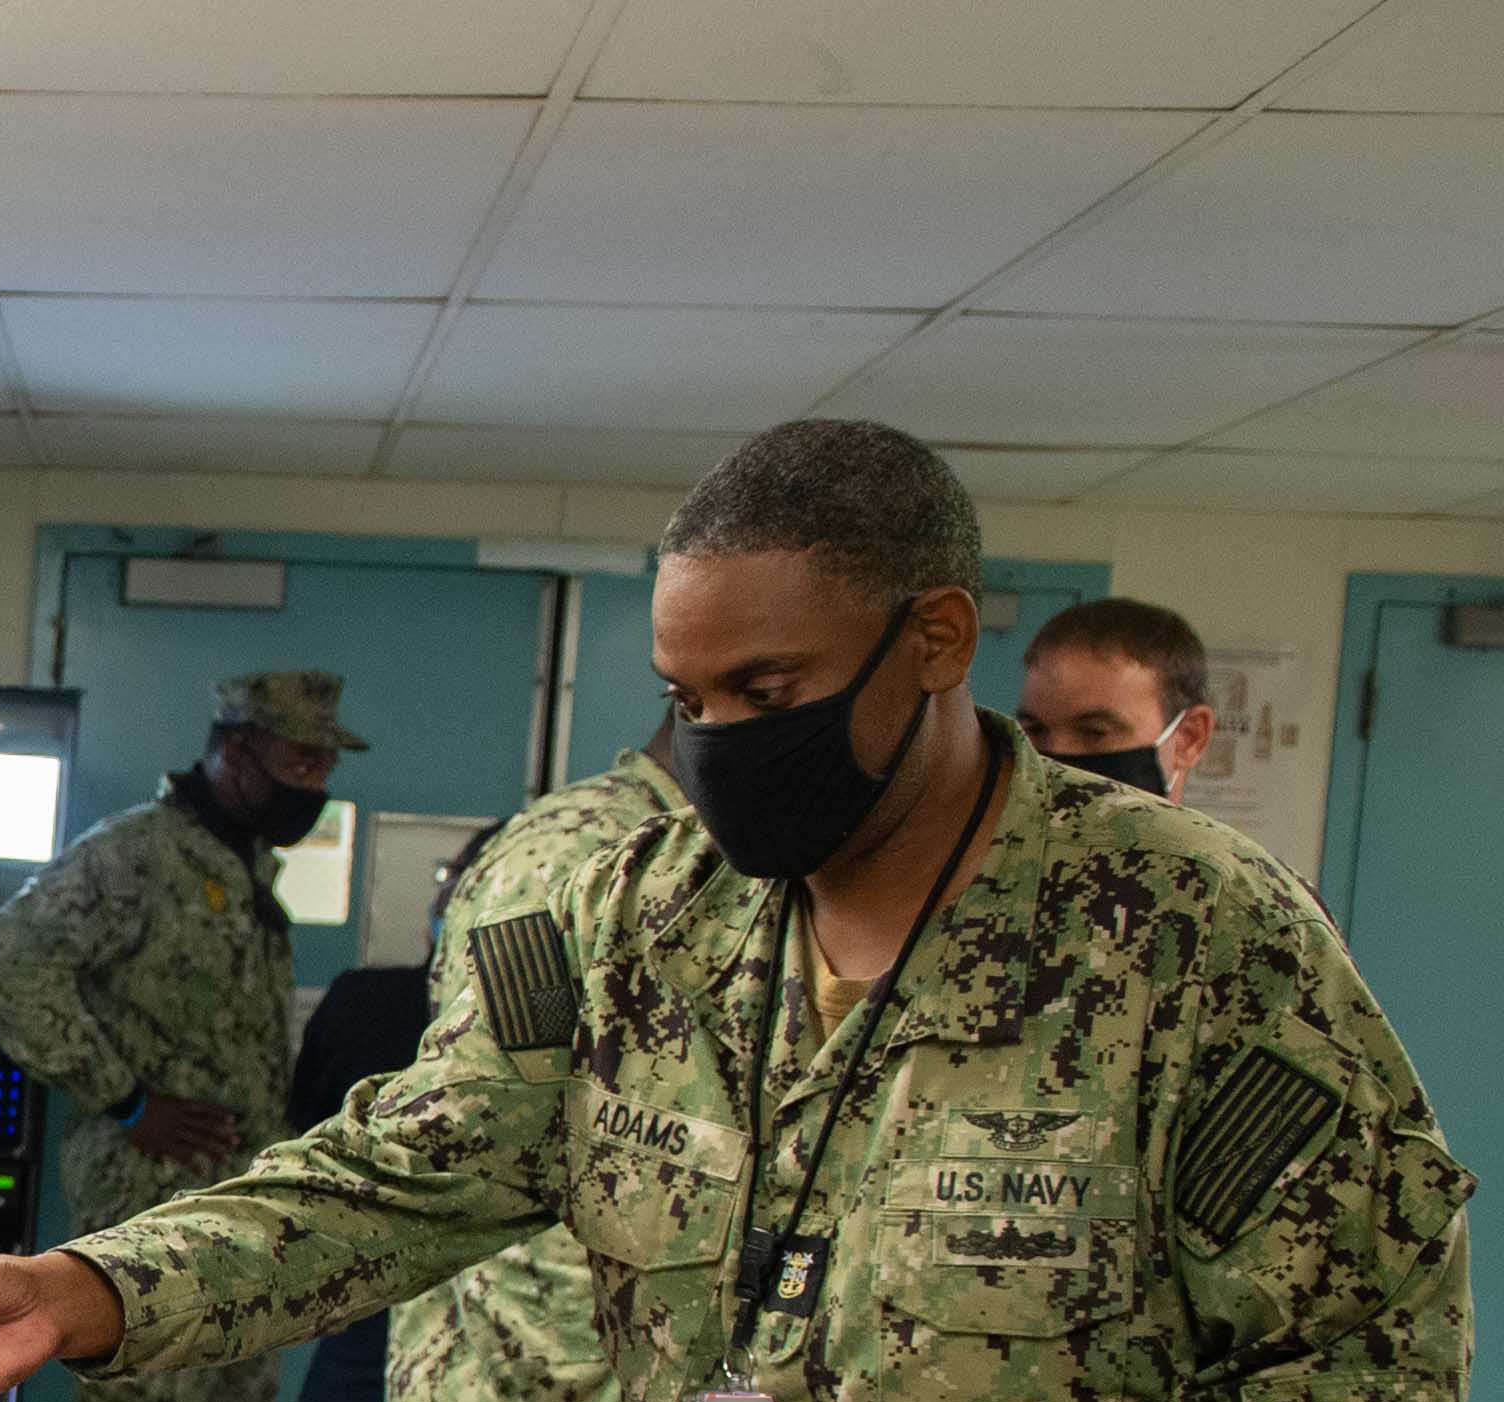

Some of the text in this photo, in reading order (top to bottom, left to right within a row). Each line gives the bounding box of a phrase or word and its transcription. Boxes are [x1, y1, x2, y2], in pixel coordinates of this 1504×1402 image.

[593, 1101, 689, 1155] ADAMS
[936, 1170, 1091, 1207] U.S. NAVY
